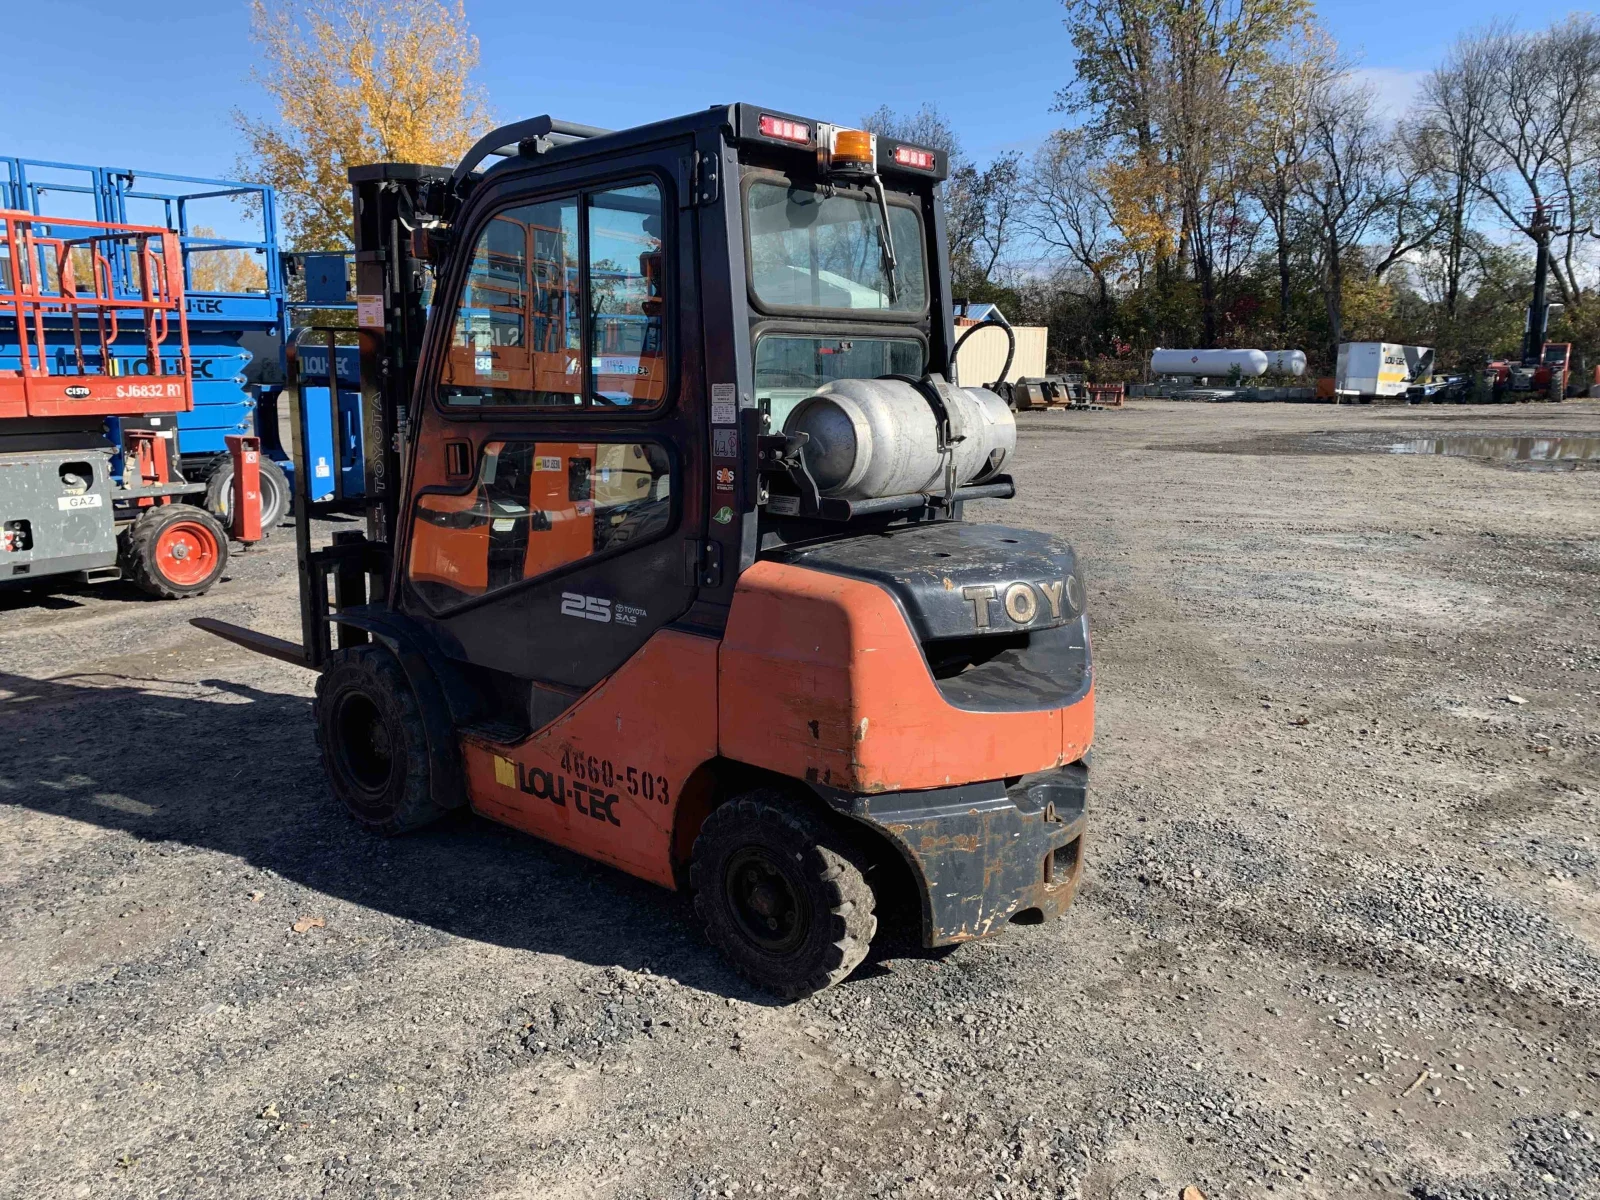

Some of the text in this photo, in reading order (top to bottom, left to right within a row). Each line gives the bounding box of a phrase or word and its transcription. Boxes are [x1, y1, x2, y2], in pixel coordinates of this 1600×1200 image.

[170, 299, 223, 313] U-TEC
[305, 357, 349, 375] LOU-EC
[116, 384, 163, 397] SJ6832
[371, 391, 386, 493] TOYOTA
[717, 467, 735, 483] SAS
[69, 496, 95, 507] GAZ
[561, 592, 647, 623] 25 TOYOTA
[615, 613, 637, 623] SAS
[517, 762, 621, 828] LOU-TEC
